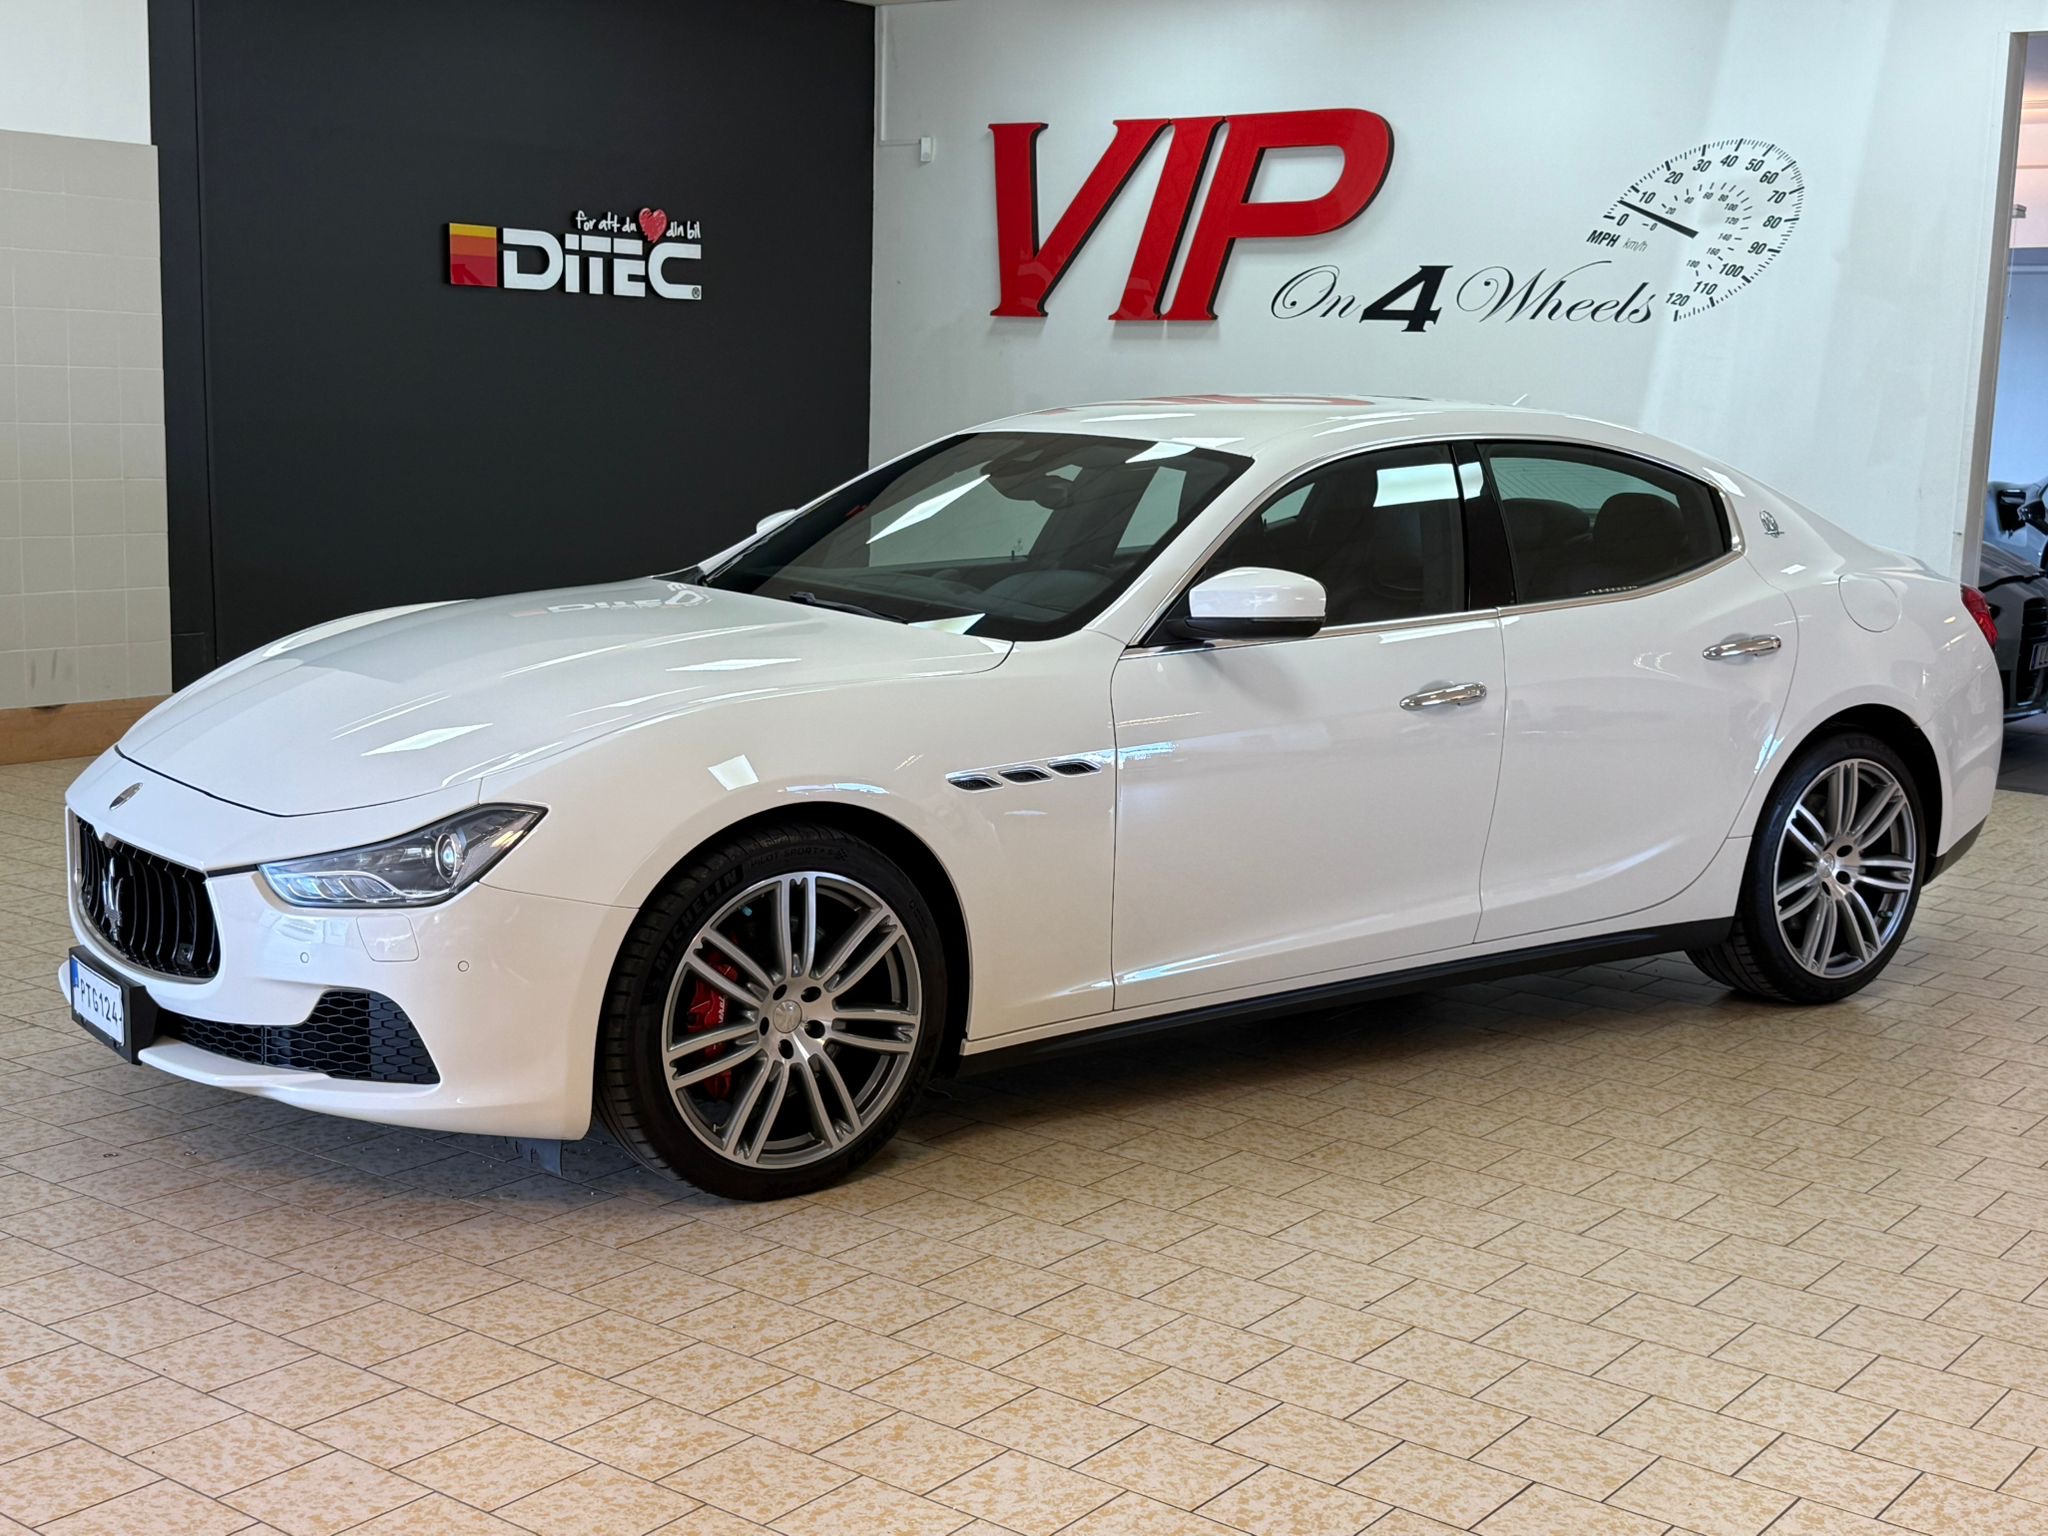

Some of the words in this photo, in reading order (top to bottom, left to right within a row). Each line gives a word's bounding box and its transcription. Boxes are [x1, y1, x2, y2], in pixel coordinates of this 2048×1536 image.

[1693, 159, 1711, 172] 30
[1720, 155, 1738, 167] 40
[1745, 159, 1765, 172] 50
[1665, 171, 1683, 184] 20
[1760, 171, 1778, 184] 60
[1639, 192, 1656, 204] 10
[1767, 191, 1786, 203] 70
[988, 108, 1394, 321] VIP
[1616, 214, 1629, 226] 0
[598, 212, 620, 232] att
[622, 217, 637, 232] du
[687, 221, 701, 239] bil
[1650, 223, 1657, 231] 0
[1763, 216, 1782, 229] 80
[1586, 230, 1620, 247] MPH
[1748, 242, 1767, 255] 90
[1719, 263, 1744, 277] 100
[1693, 282, 1718, 295] 110
[1270, 265, 1364, 322] On
[1359, 265, 1454, 333] 4
[1456, 261, 1654, 324] Wheels
[1666, 293, 1690, 306] 120
[654, 866, 740, 973] MICHELIN
